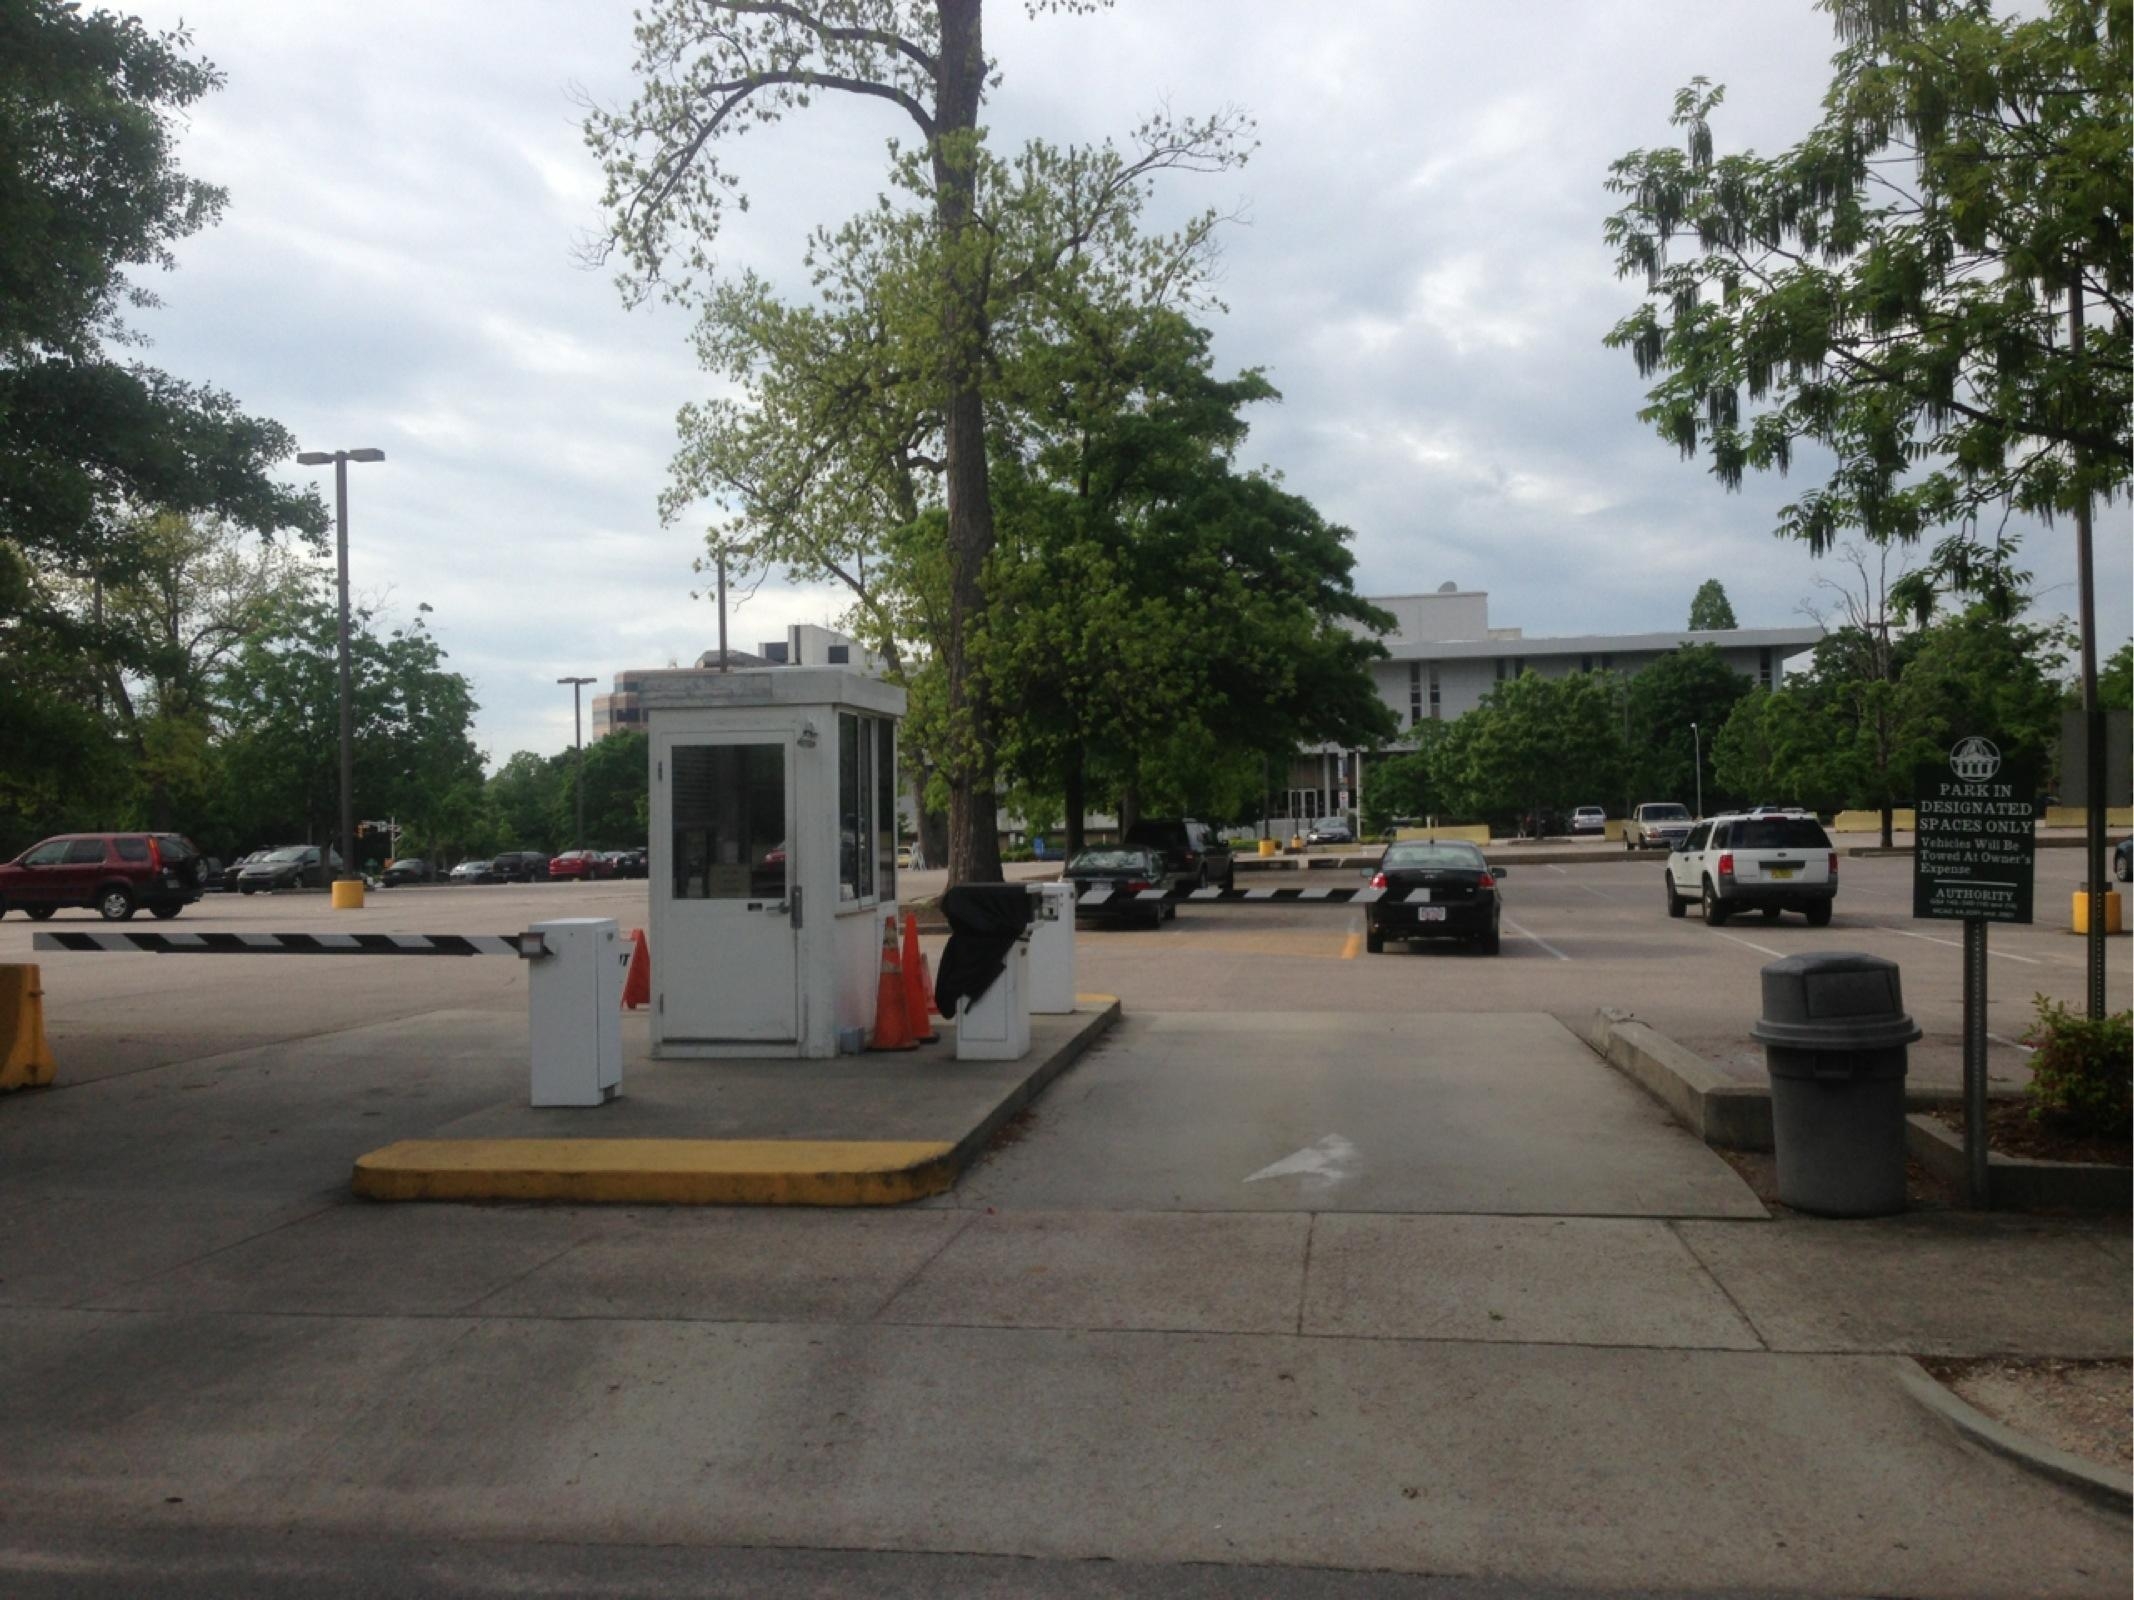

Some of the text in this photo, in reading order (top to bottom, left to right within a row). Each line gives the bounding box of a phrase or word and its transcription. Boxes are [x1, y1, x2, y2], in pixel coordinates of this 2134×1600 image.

[1940, 783, 2012, 798] PARK IN
[1921, 800, 2033, 816] DESIGNATED
[1920, 818, 2032, 834] SPACES ONLY
[1921, 837, 2020, 851] Vehicles Will Be
[1920, 849, 2031, 865] Towed At Owner's
[1920, 862, 1971, 876] Expense
[1936, 888, 2014, 901] AUTHORITY
